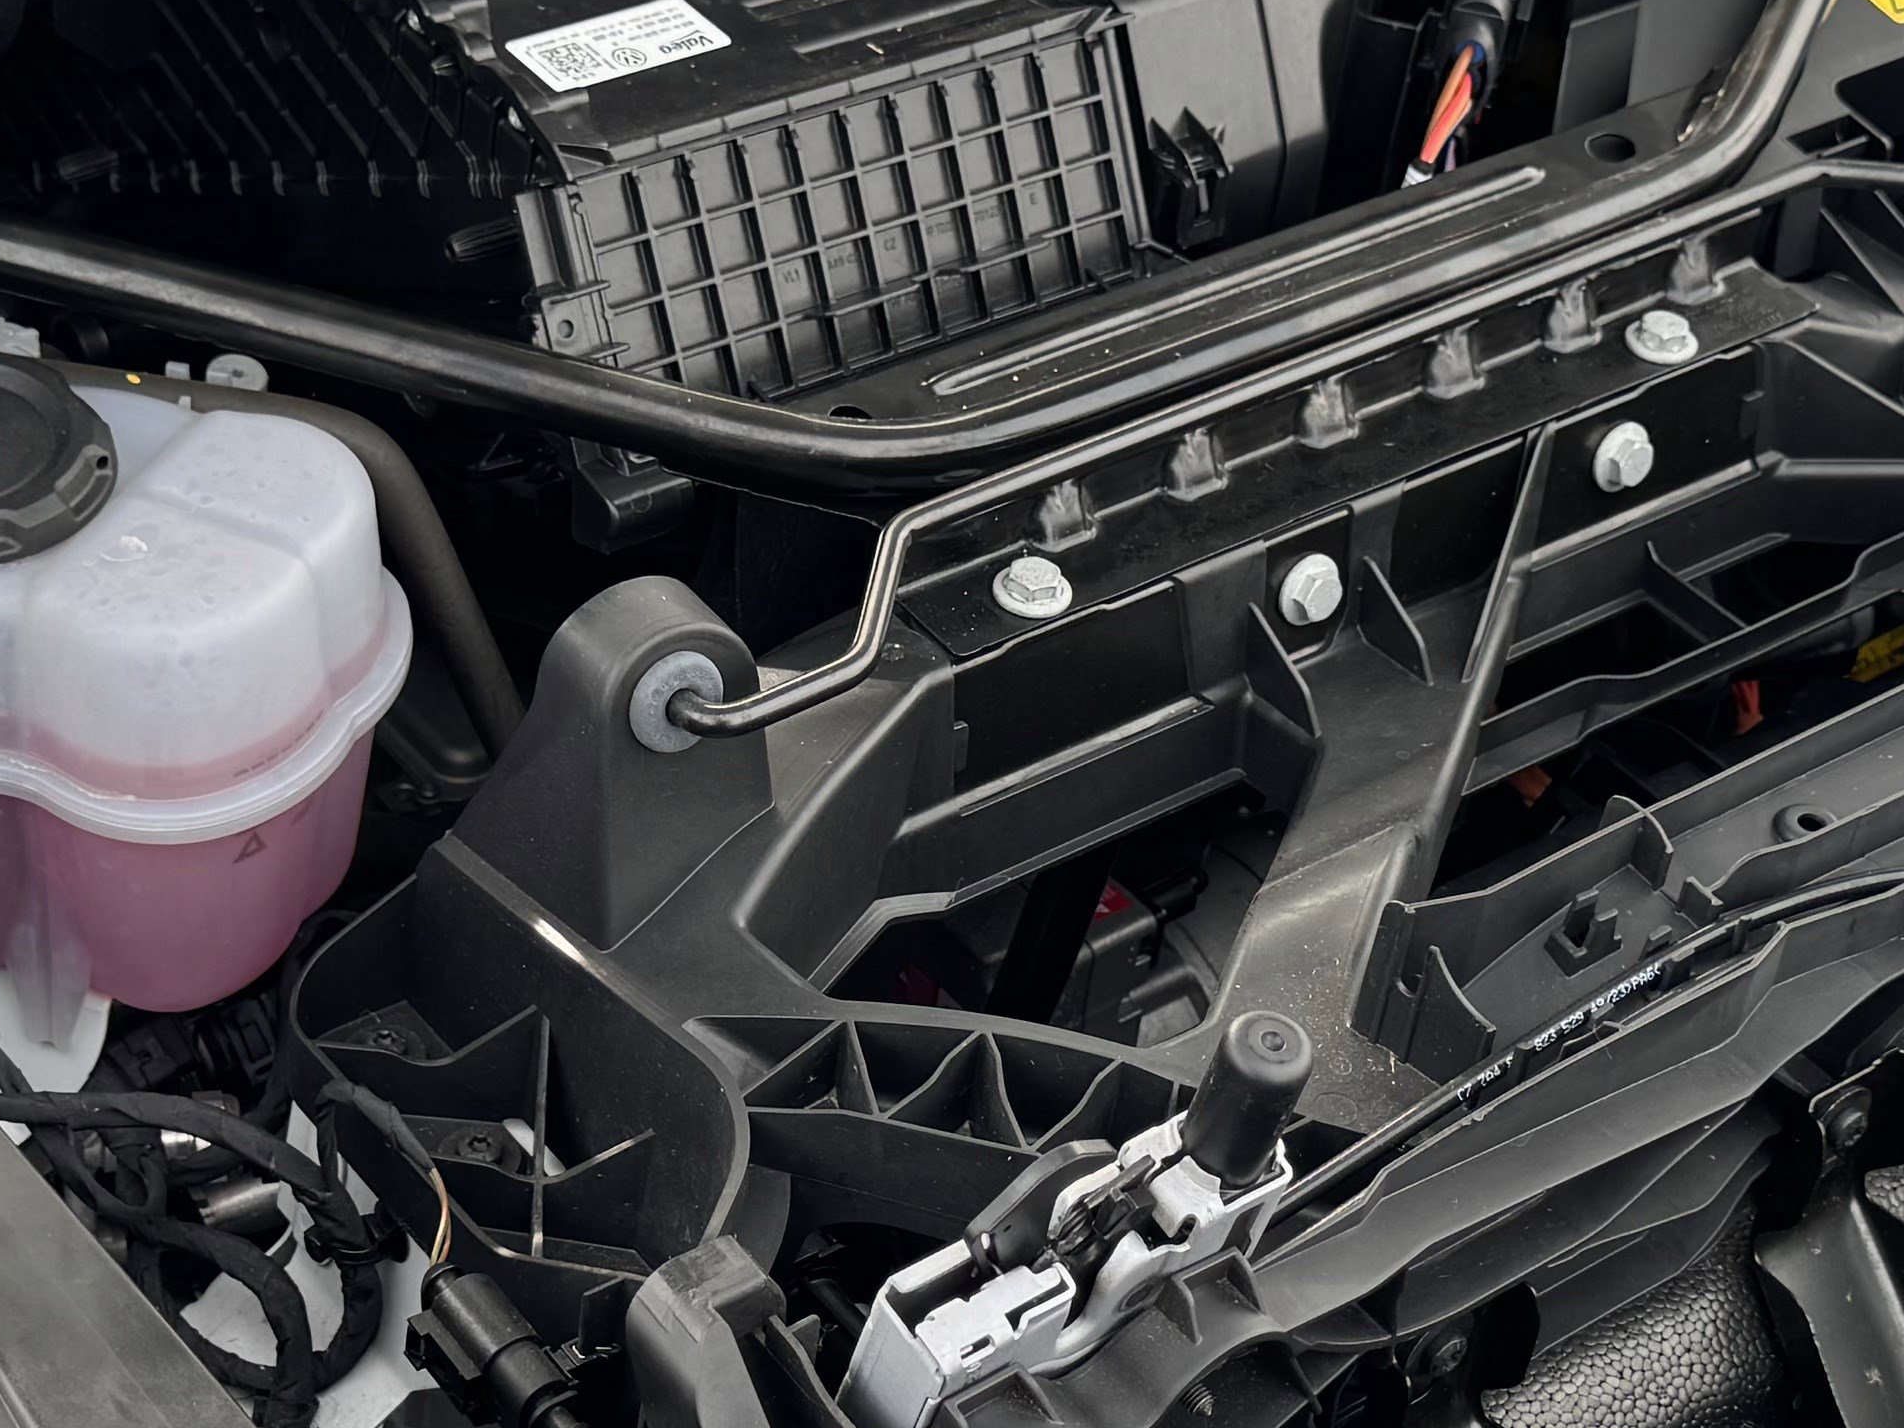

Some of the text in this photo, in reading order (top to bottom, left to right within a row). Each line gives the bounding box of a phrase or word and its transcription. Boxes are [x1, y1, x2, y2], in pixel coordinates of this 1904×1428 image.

[662, 33, 713, 58] Valeo
[1533, 1029, 1559, 1051] 823
[1560, 1011, 1586, 1033] 529
